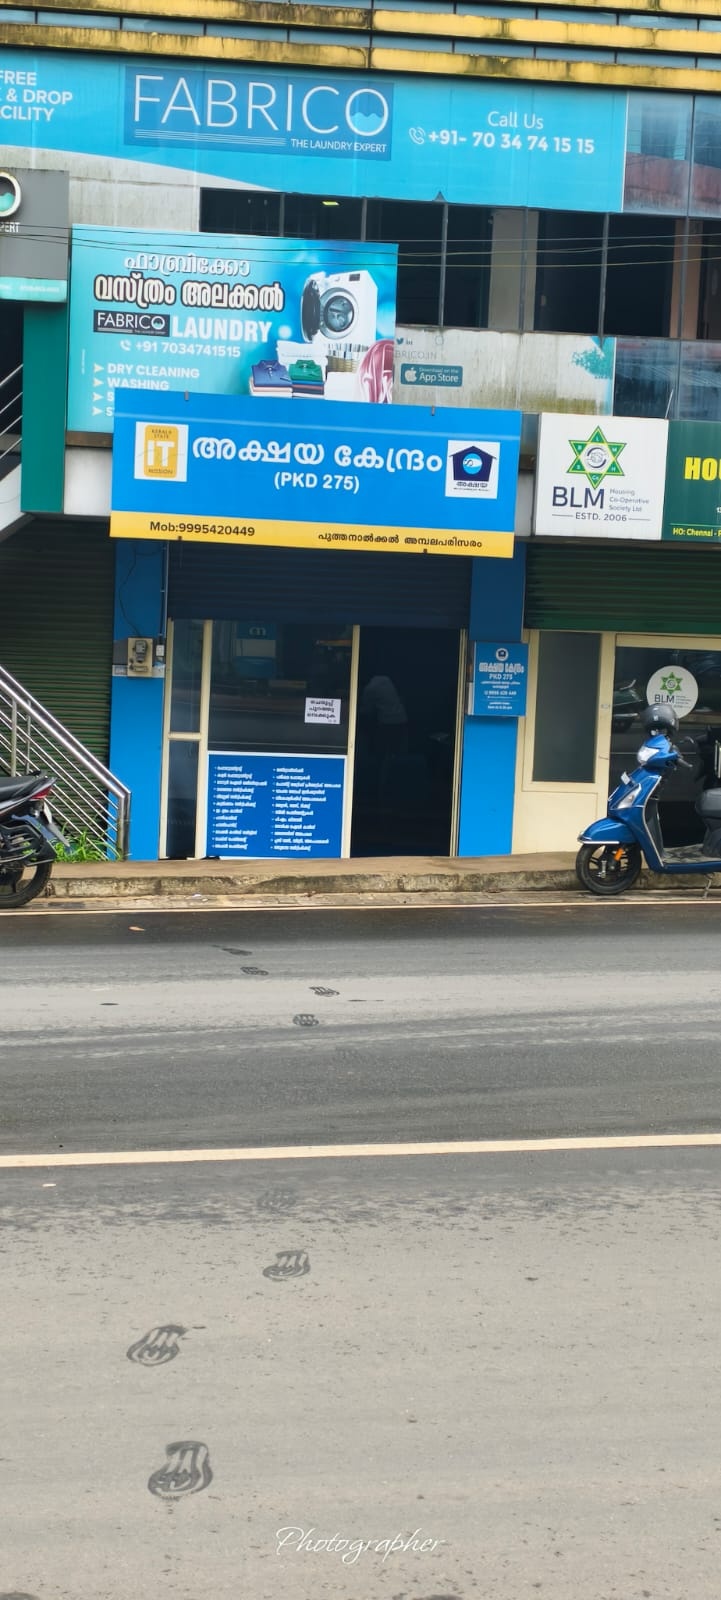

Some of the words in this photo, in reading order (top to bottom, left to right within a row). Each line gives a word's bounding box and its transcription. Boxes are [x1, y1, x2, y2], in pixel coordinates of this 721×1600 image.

[6, 88, 18, 102] &
[23, 89, 73, 105] DROP
[134, 75, 389, 137] FABRICO
[488, 111, 518, 128] Call
[524, 113, 544, 130] Us
[291, 138, 309, 148] THE
[310, 140, 353, 150] LAUNDRY
[354, 142, 387, 153] EXPERT
[428, 130, 467, 145] +91-
[473, 132, 495, 148] 70
[501, 134, 522, 150] 34
[527, 136, 548, 151] 74
[554, 137, 571, 153] 15
[577, 138, 595, 154] 15
[94, 272, 177, 309] വസ്ത്രം
[182, 281, 285, 312] അലക്കൽ
[97, 312, 166, 330] FABRICO
[172, 316, 273, 343] LAUNDRY
[135, 341, 158, 353] +91
[161, 342, 241, 357] 7034741515
[107, 363, 133, 375] DRY
[136, 365, 200, 378] CLEANING
[420, 372, 437, 383] App
[438, 372, 459, 383] Store
[107, 378, 170, 390] WASHING
[147, 440, 175, 467] IT
[192, 437, 325, 465] അക്ഷയ
[334, 445, 443, 473] കേന്ദ്രം
[274, 472, 318, 490] (PKD
[322, 474, 360, 494] 275)
[552, 486, 605, 509] BLM
[576, 512, 600, 521] ESTD.
[604, 514, 627, 522] 2006
[150, 521, 255, 536] Mob:9995420449
[686, 528, 713, 537] Chennai
[655, 694, 675, 704] BLM
